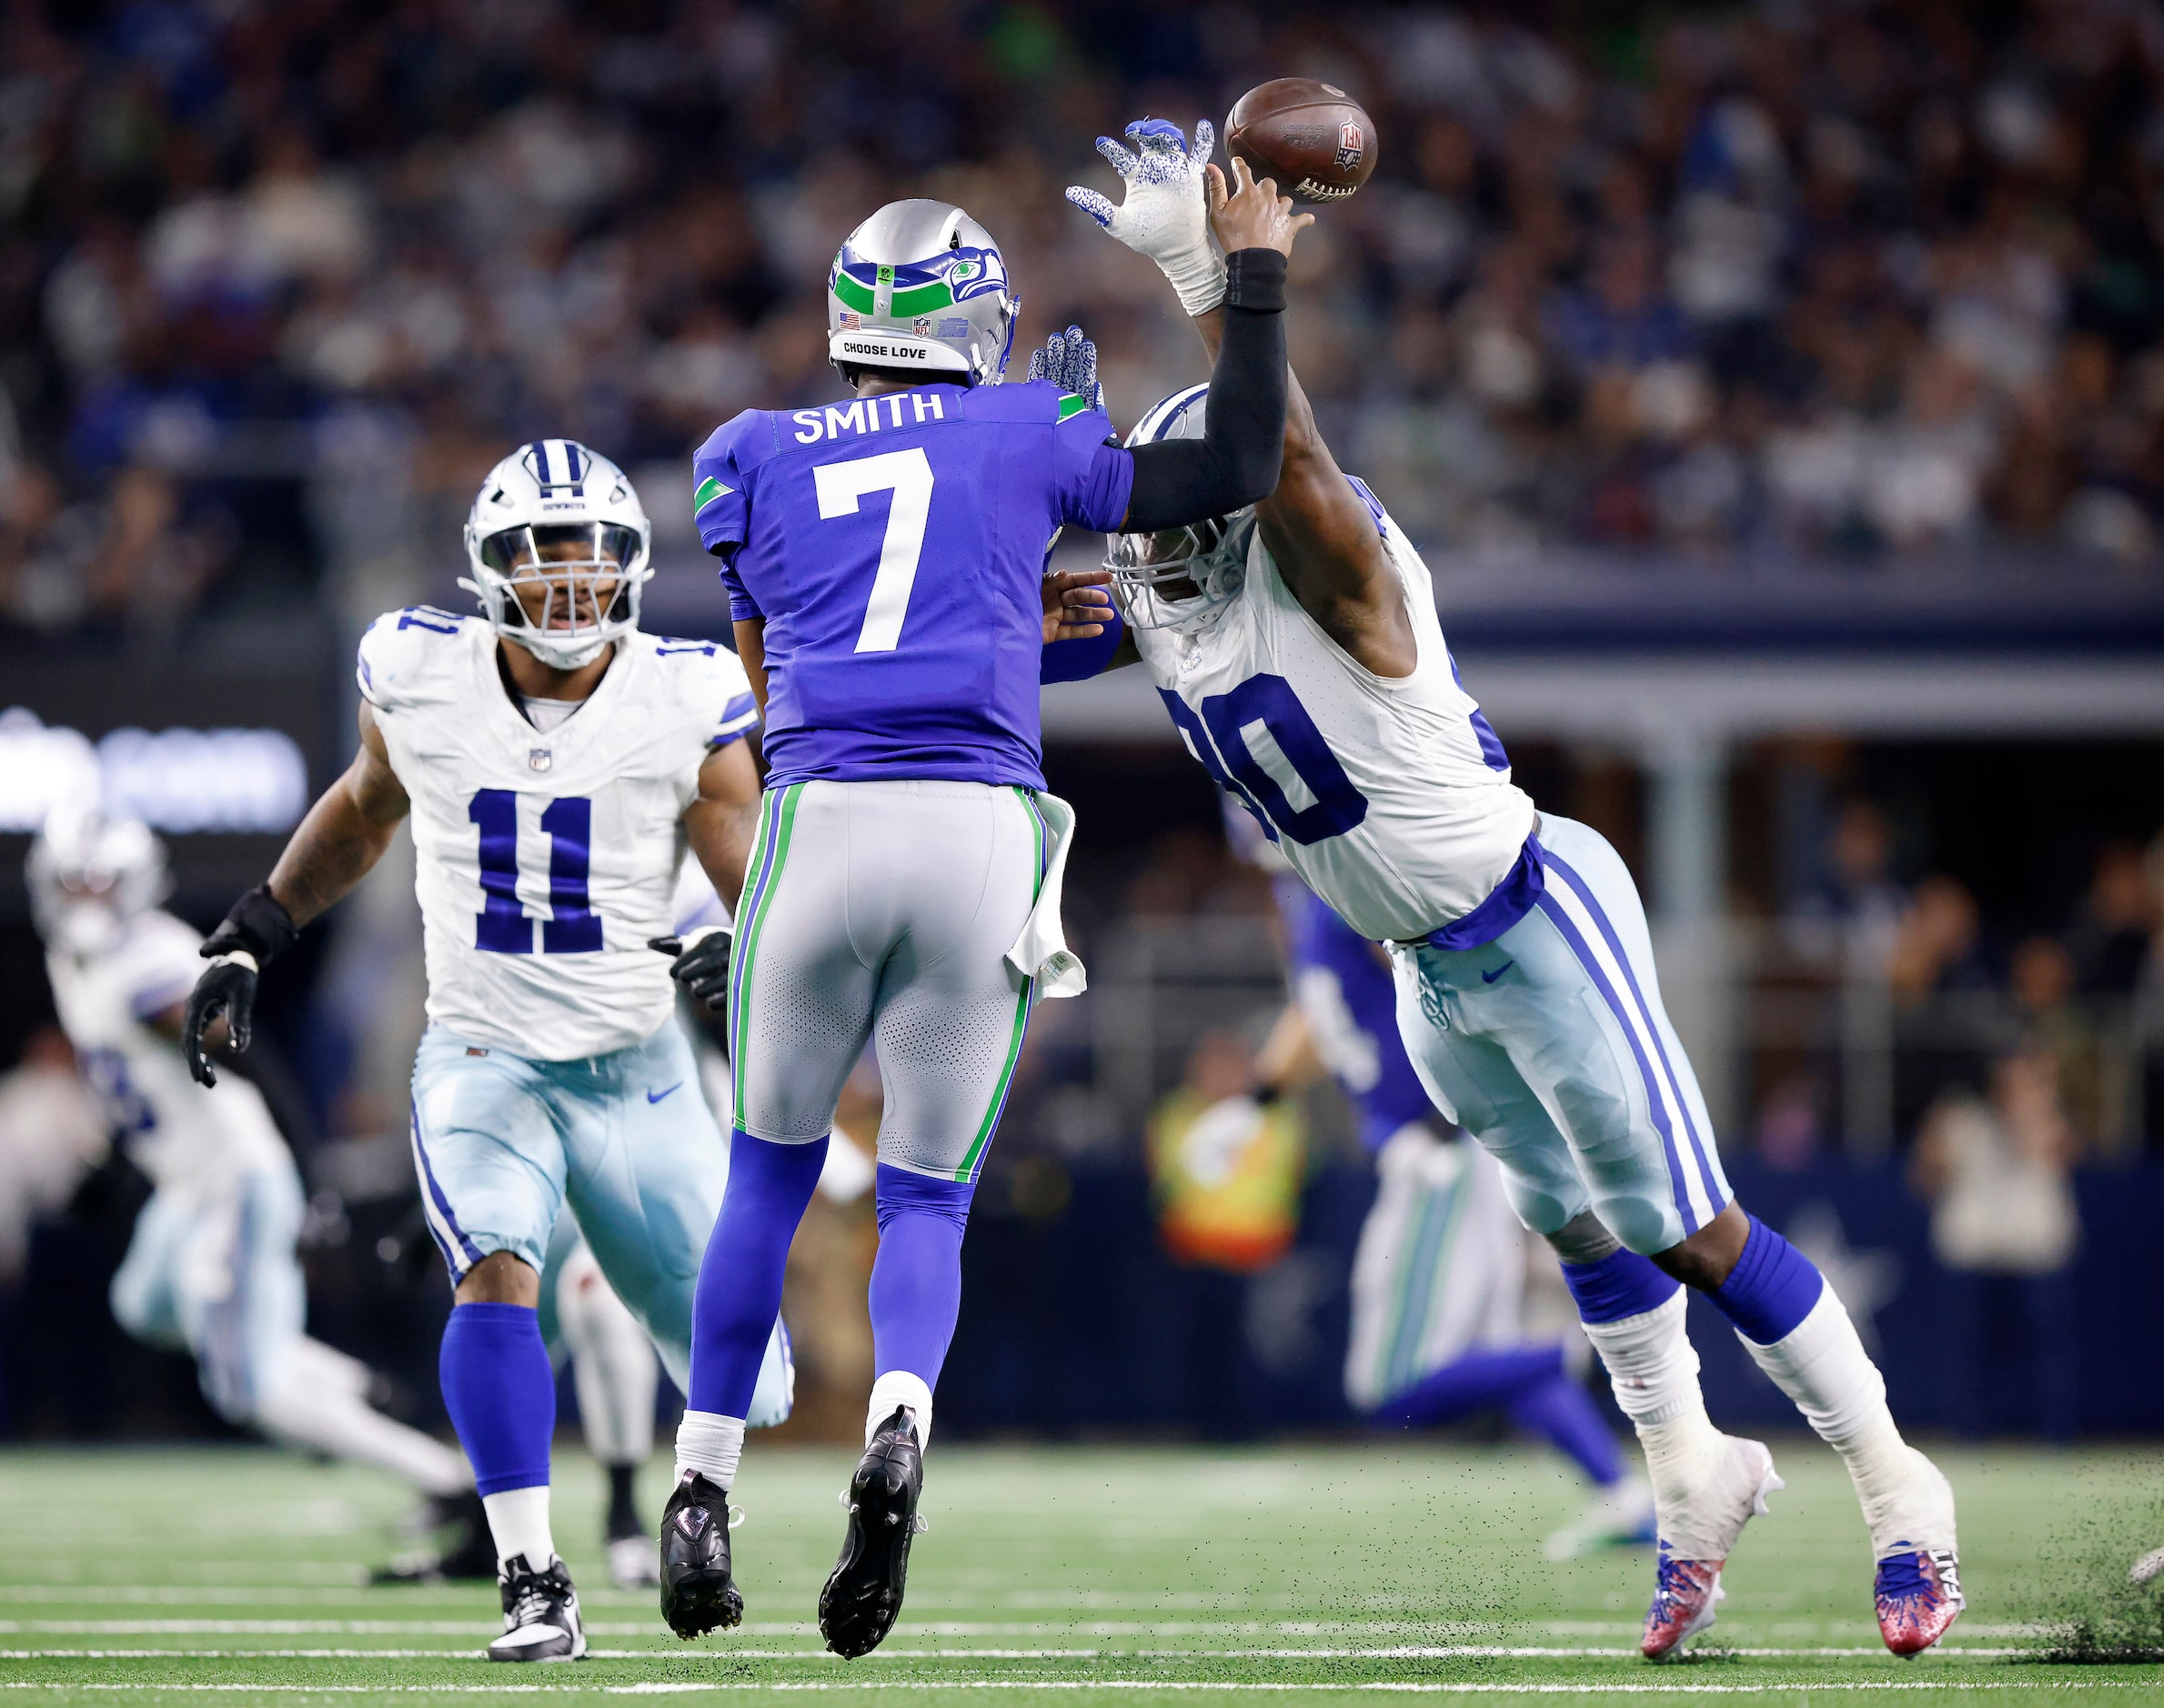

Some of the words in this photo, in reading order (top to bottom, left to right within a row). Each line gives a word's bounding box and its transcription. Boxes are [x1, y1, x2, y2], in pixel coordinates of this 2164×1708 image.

[1342, 126, 1361, 149] NFL
[914, 326, 929, 336] NFL
[843, 342, 888, 356] CHOOSE
[891, 347, 927, 359] LOVE
[792, 393, 944, 444] SMITH
[812, 447, 935, 653] 7
[468, 788, 603, 954] 11
